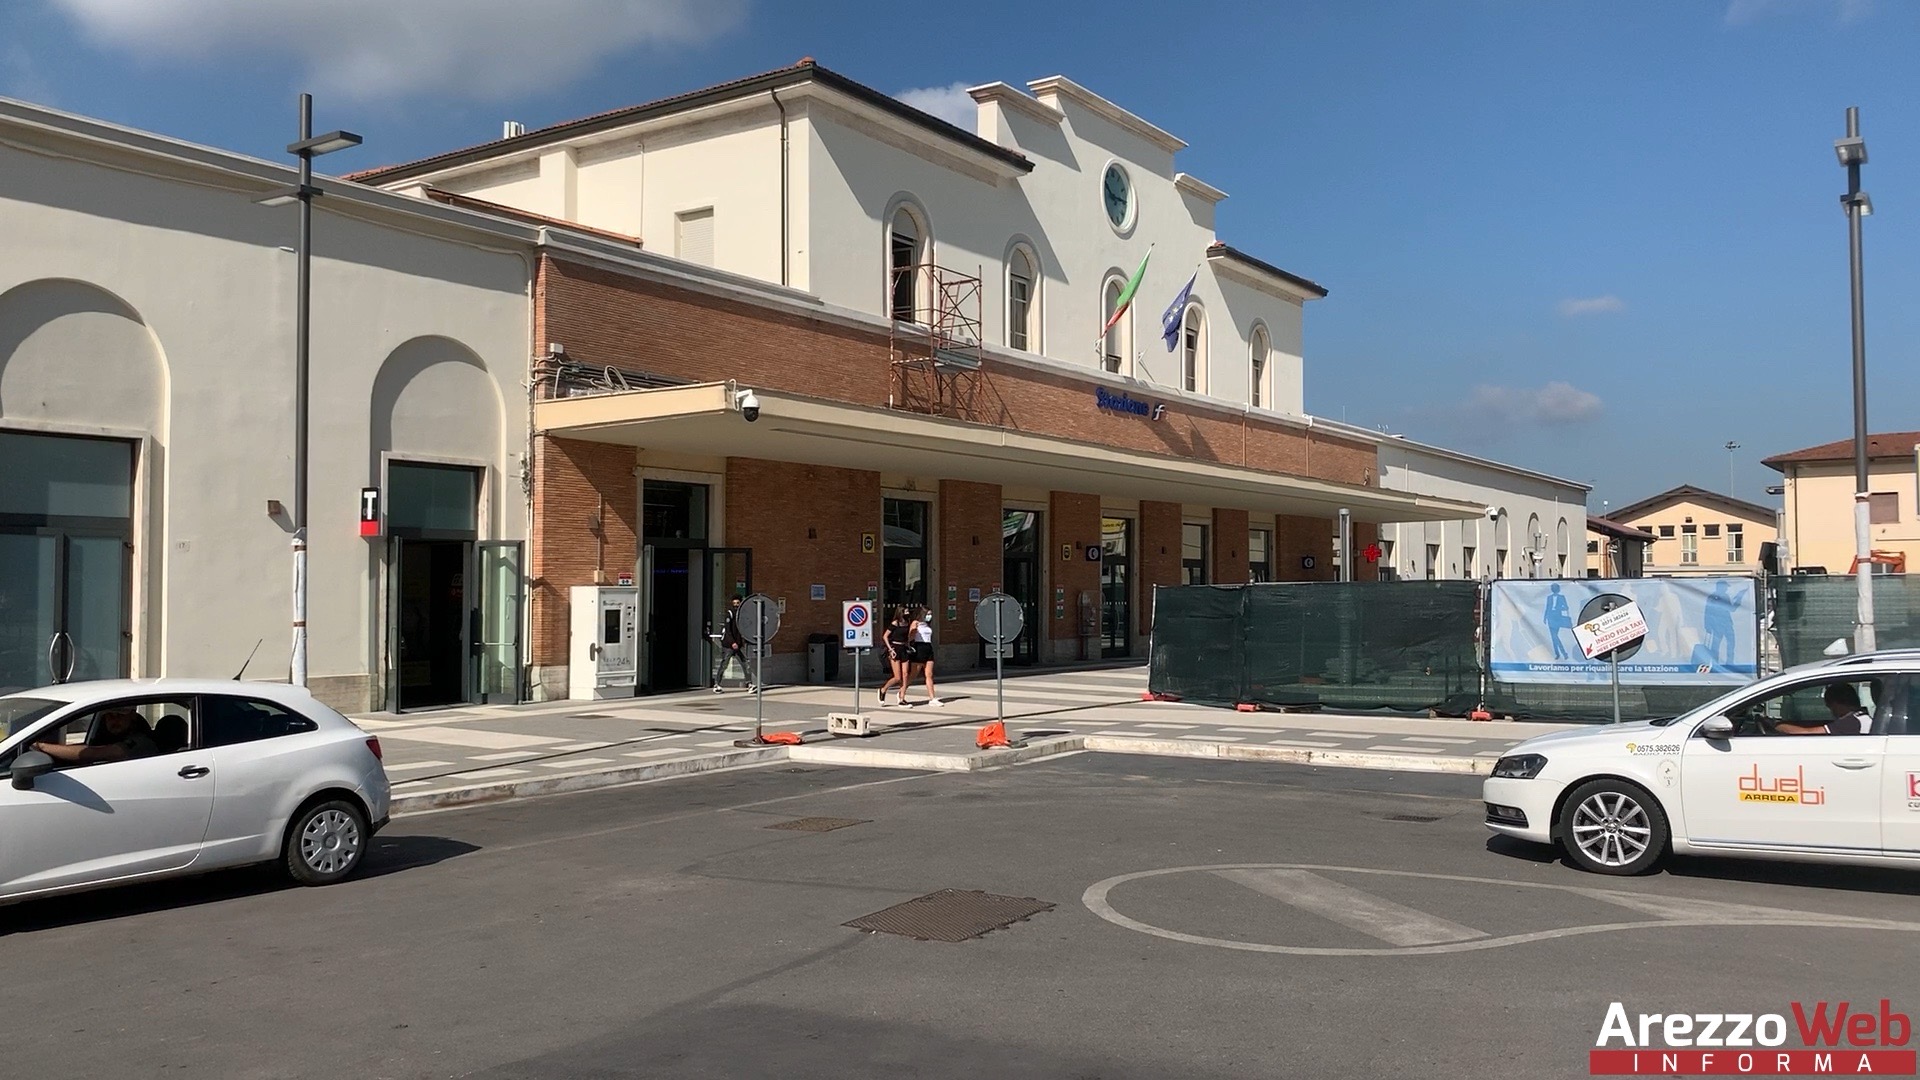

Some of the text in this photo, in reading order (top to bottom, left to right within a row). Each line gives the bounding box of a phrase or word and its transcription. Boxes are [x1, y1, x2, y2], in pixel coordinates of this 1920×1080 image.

[1096, 386, 1149, 416] Stazione
[363, 491, 377, 520] T
[1595, 632, 1616, 644] INIZIO
[1616, 626, 1630, 635] FILA
[1630, 620, 1644, 630] TAXI
[1596, 645, 1609, 653] HERE
[1609, 640, 1619, 648] FOR
[1620, 635, 1630, 643] THE
[1528, 664, 1570, 672] Lavoriamo
[1571, 665, 1584, 674] per
[1637, 744, 1680, 752] 0575.382626
[1744, 793, 1796, 803] ARREDA
